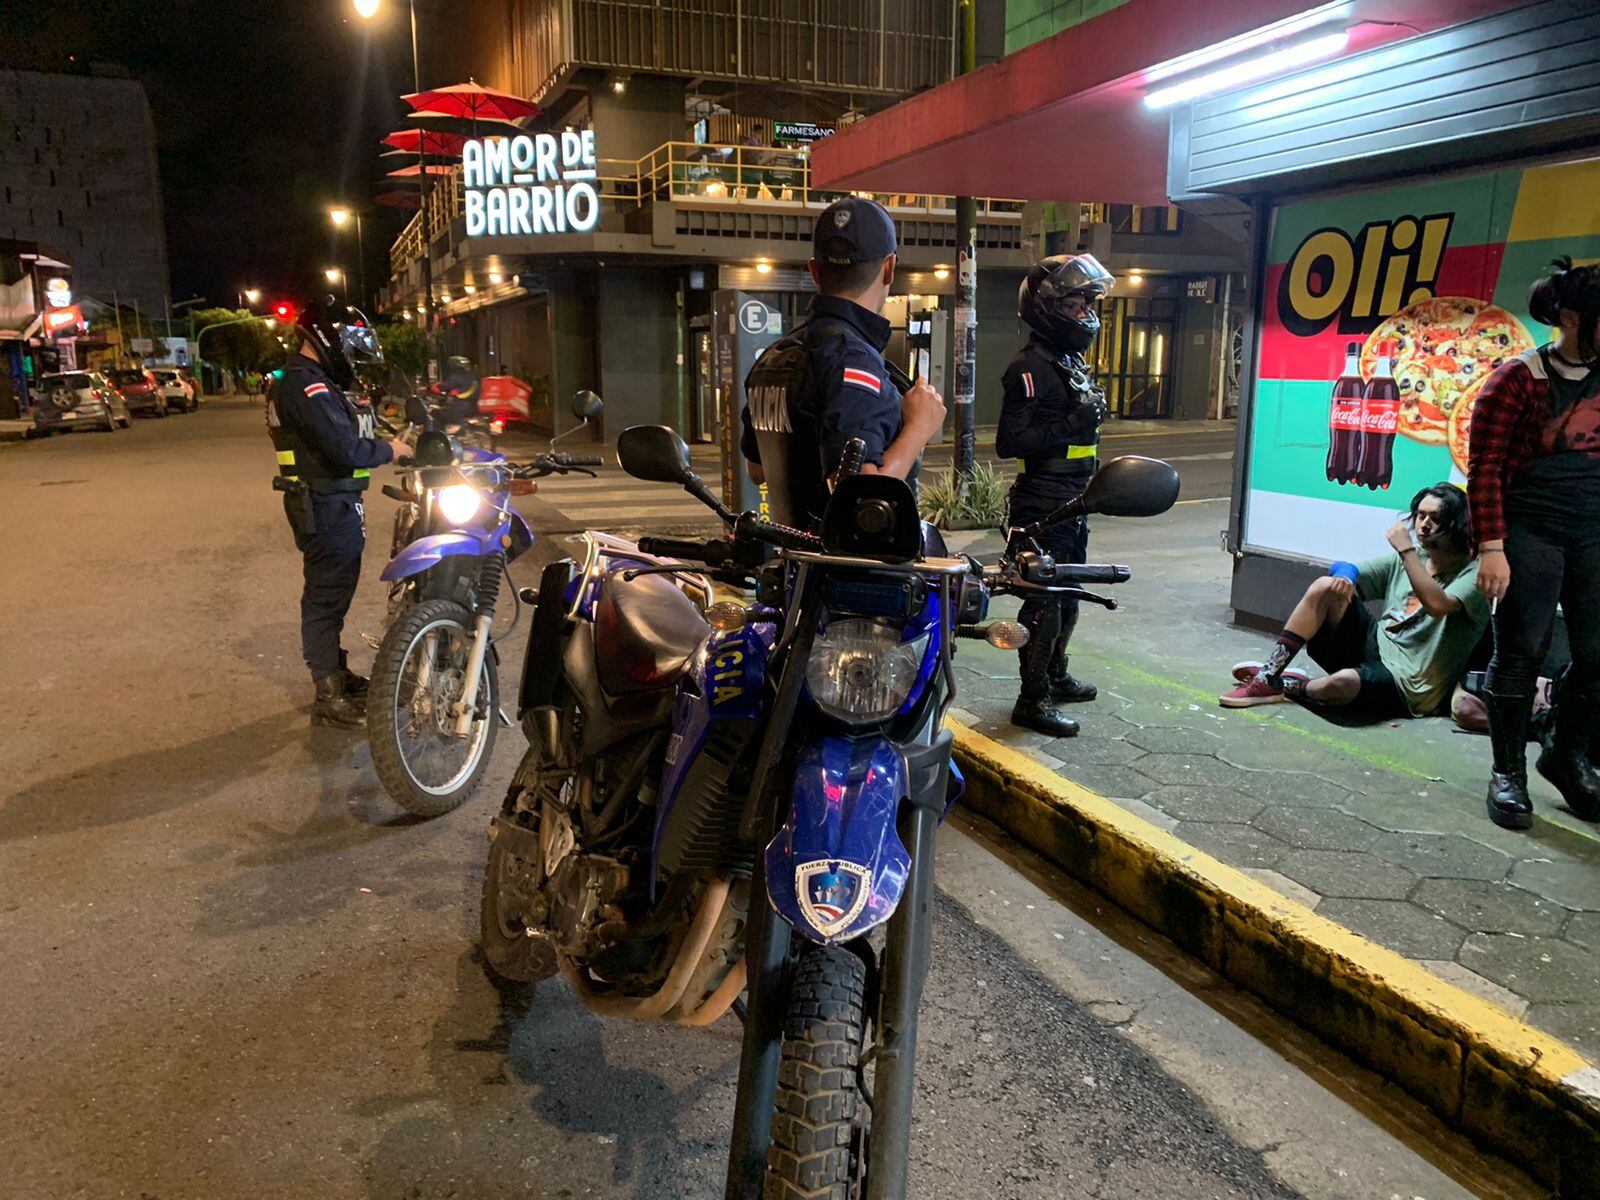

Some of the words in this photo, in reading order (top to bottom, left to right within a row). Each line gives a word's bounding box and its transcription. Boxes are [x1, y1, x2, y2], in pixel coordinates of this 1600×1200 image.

[462, 133, 559, 188] AMOR
[561, 130, 597, 168] DE
[465, 182, 599, 237] BARRIO
[1283, 214, 1455, 326] Oli!
[746, 306, 762, 329] E
[713, 625, 746, 706] LICIA
